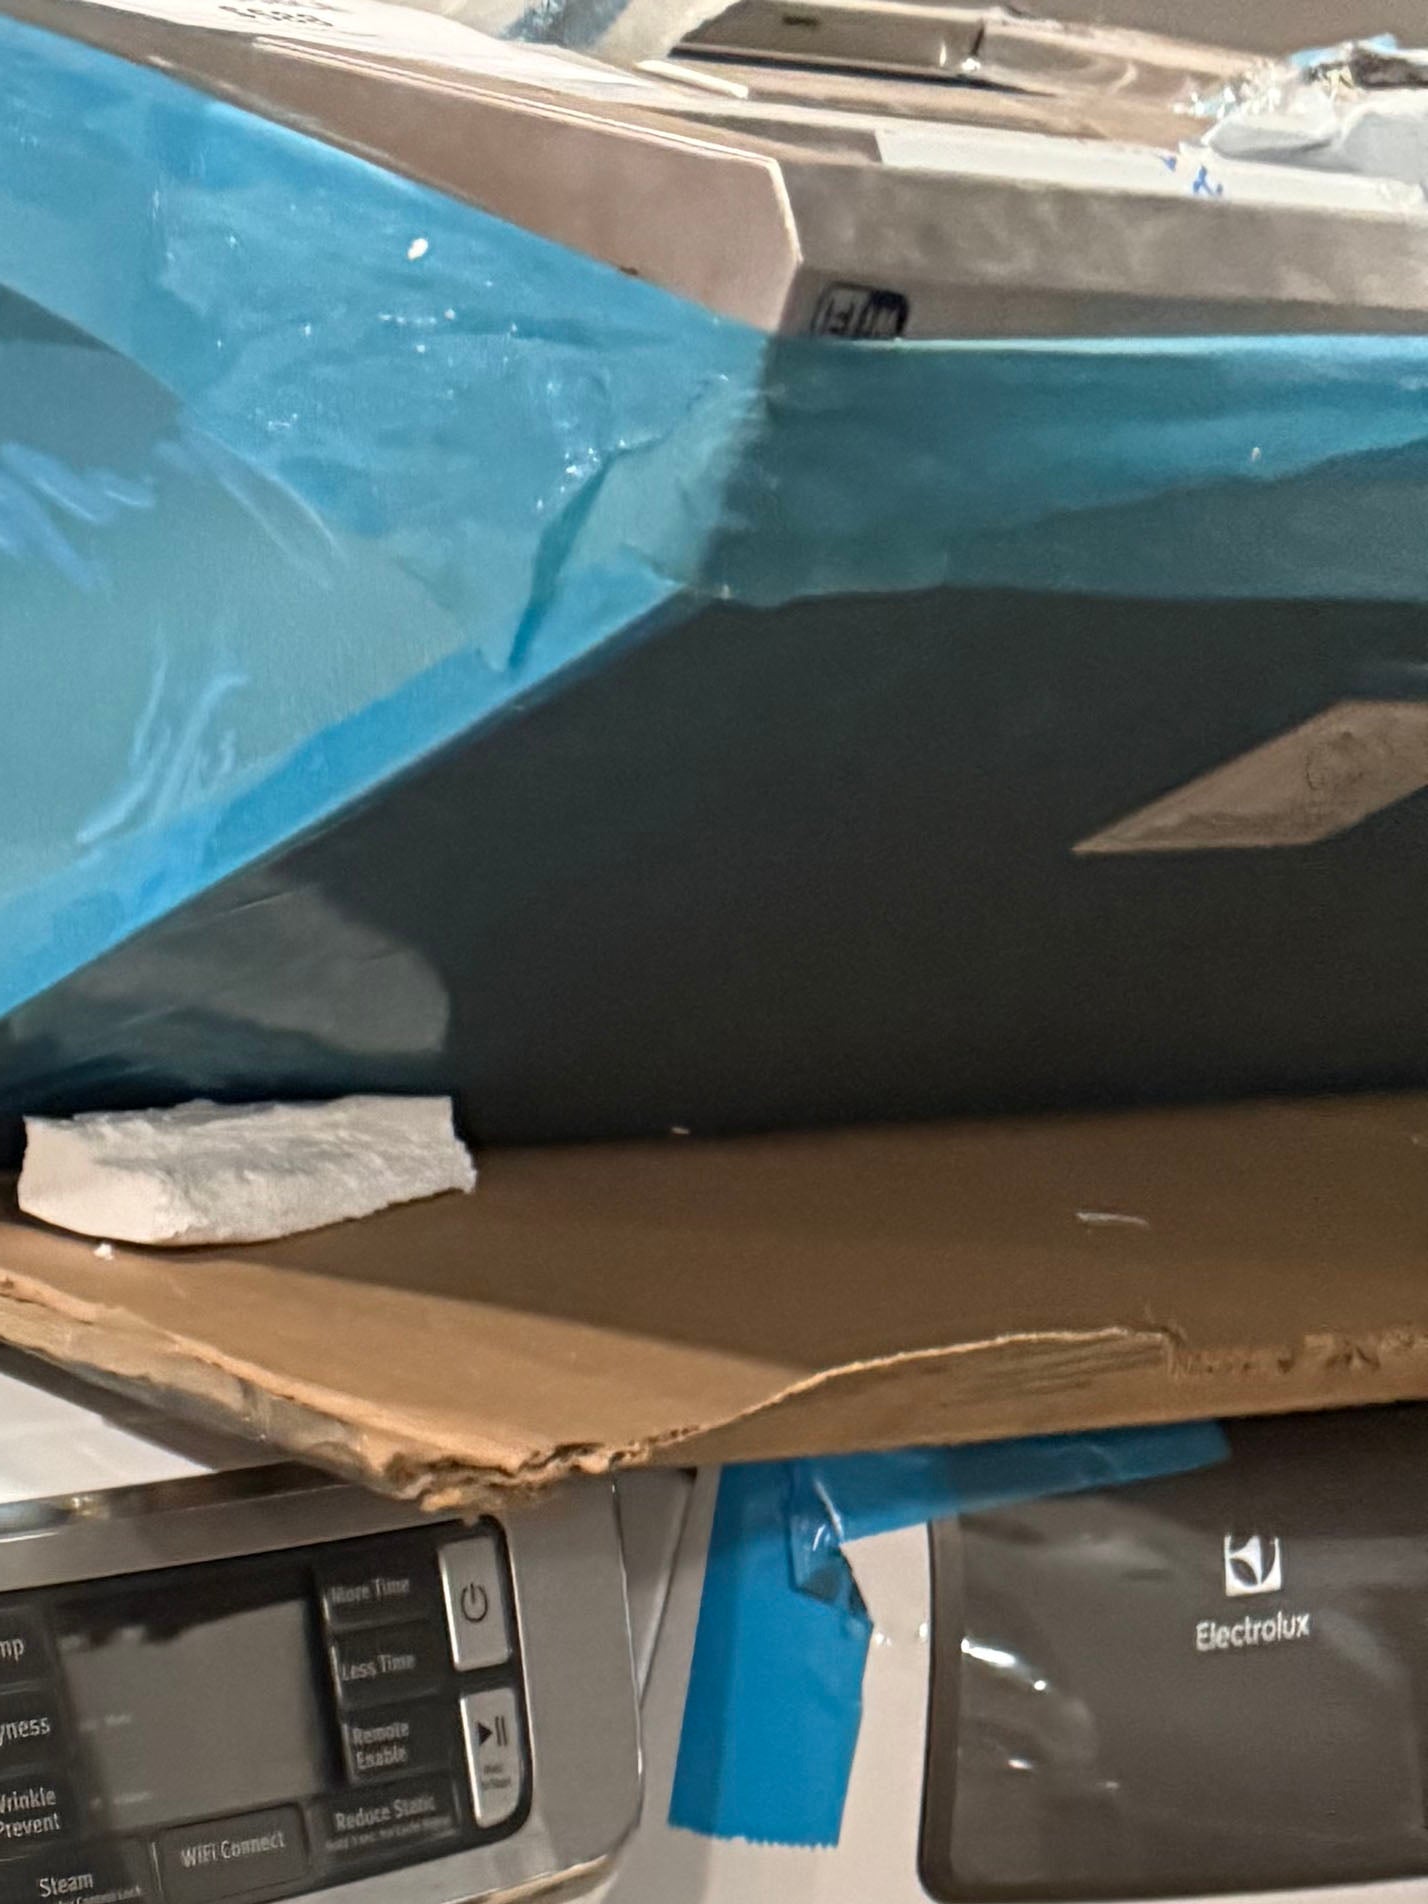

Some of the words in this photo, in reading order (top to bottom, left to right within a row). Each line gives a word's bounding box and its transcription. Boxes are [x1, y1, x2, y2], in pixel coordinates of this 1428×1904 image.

[1196, 1611, 1310, 1651] Electrolux
[221, 1831, 285, 1859] Connect
[39, 1873, 94, 1897] Steam
